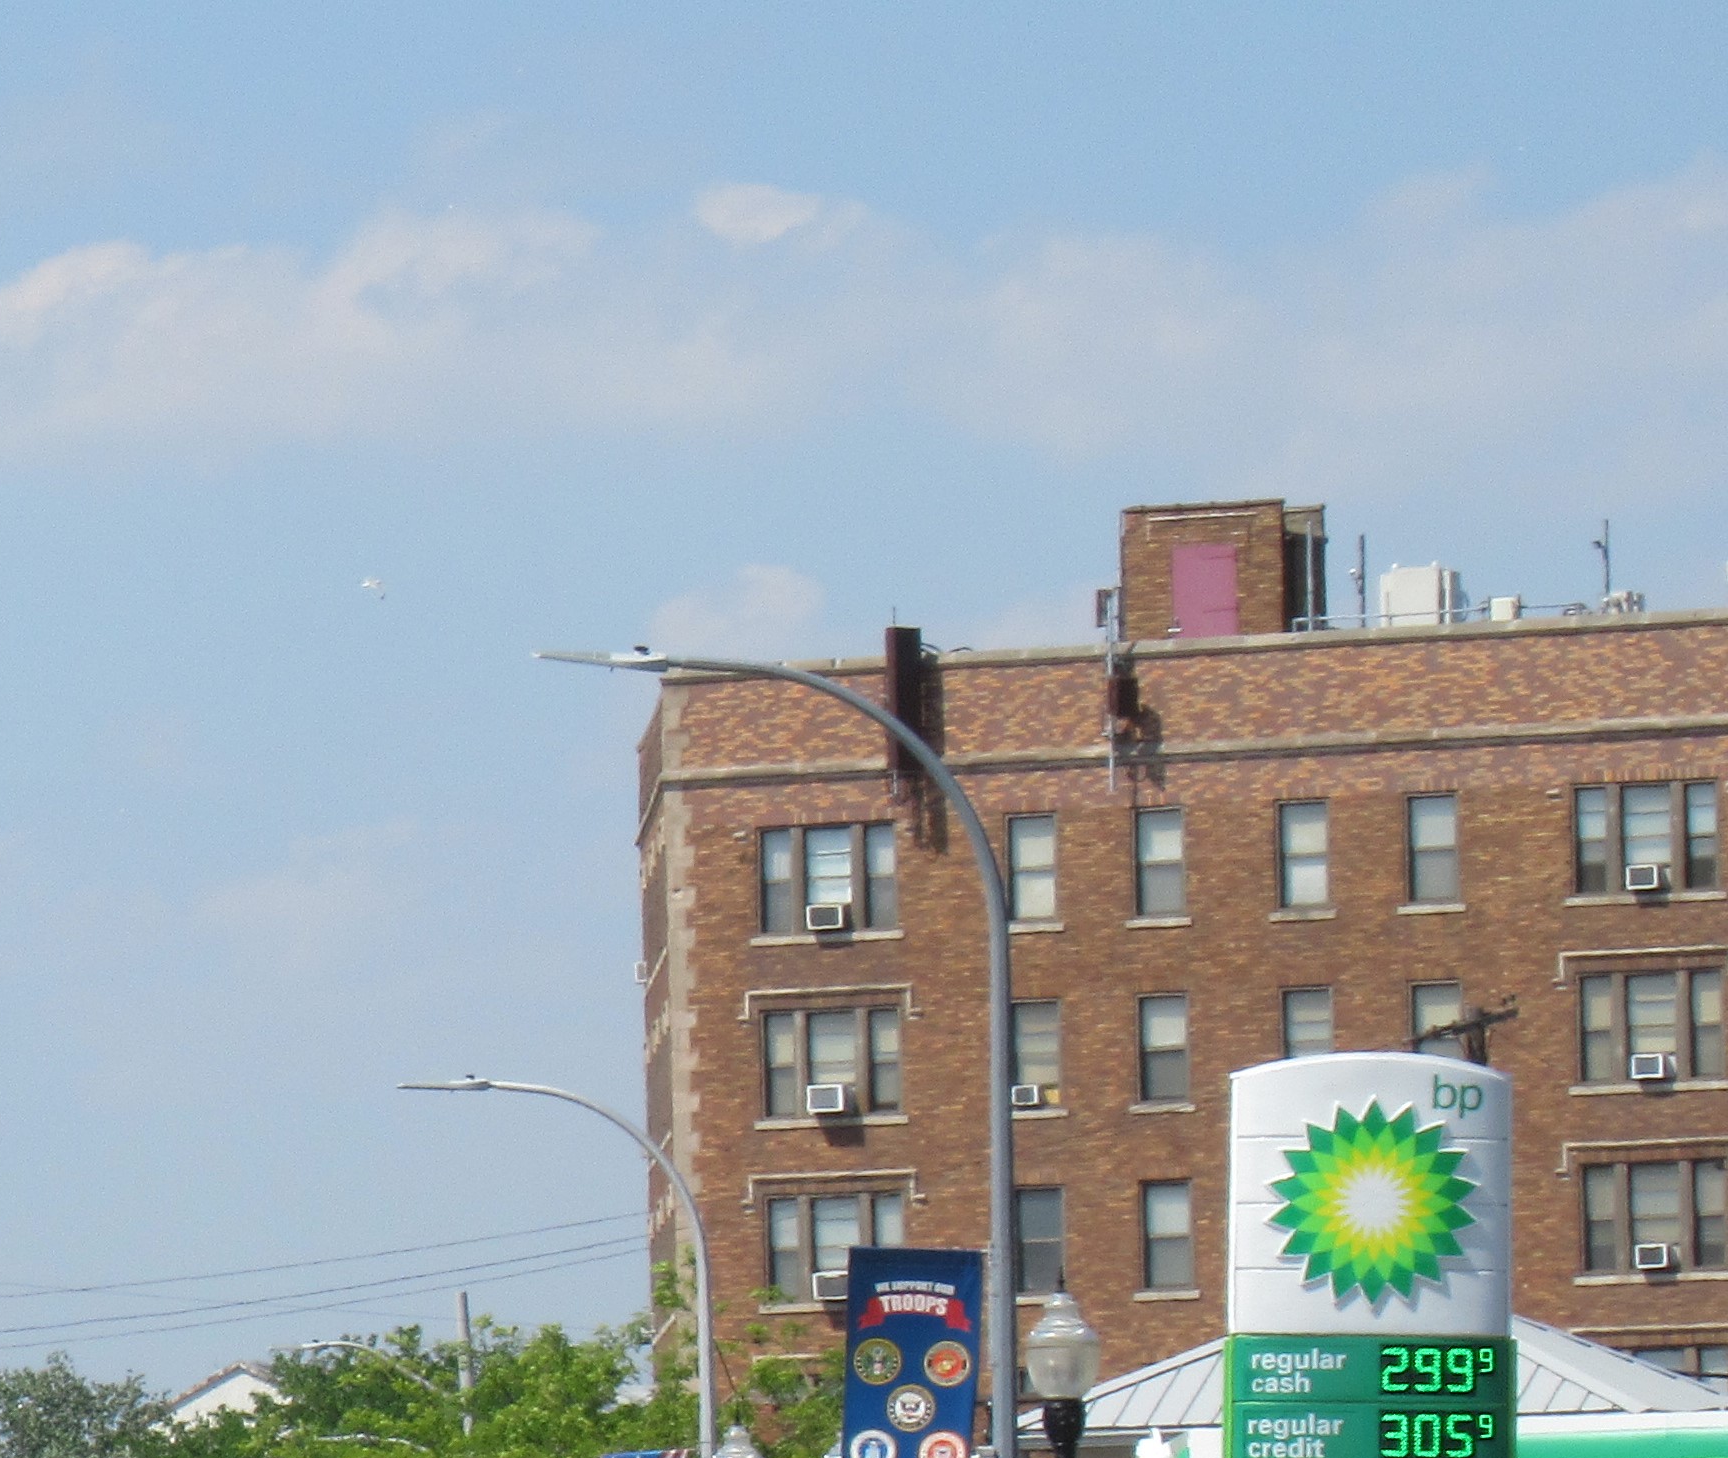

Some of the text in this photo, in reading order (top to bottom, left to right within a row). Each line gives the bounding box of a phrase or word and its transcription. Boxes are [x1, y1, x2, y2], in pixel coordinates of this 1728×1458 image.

[1431, 1074, 1483, 1119] bp
[878, 1293, 949, 1316] TROOPS
[1250, 1347, 1347, 1374] regular
[1250, 1371, 1311, 1395] cash
[1247, 1414, 1344, 1440] regular
